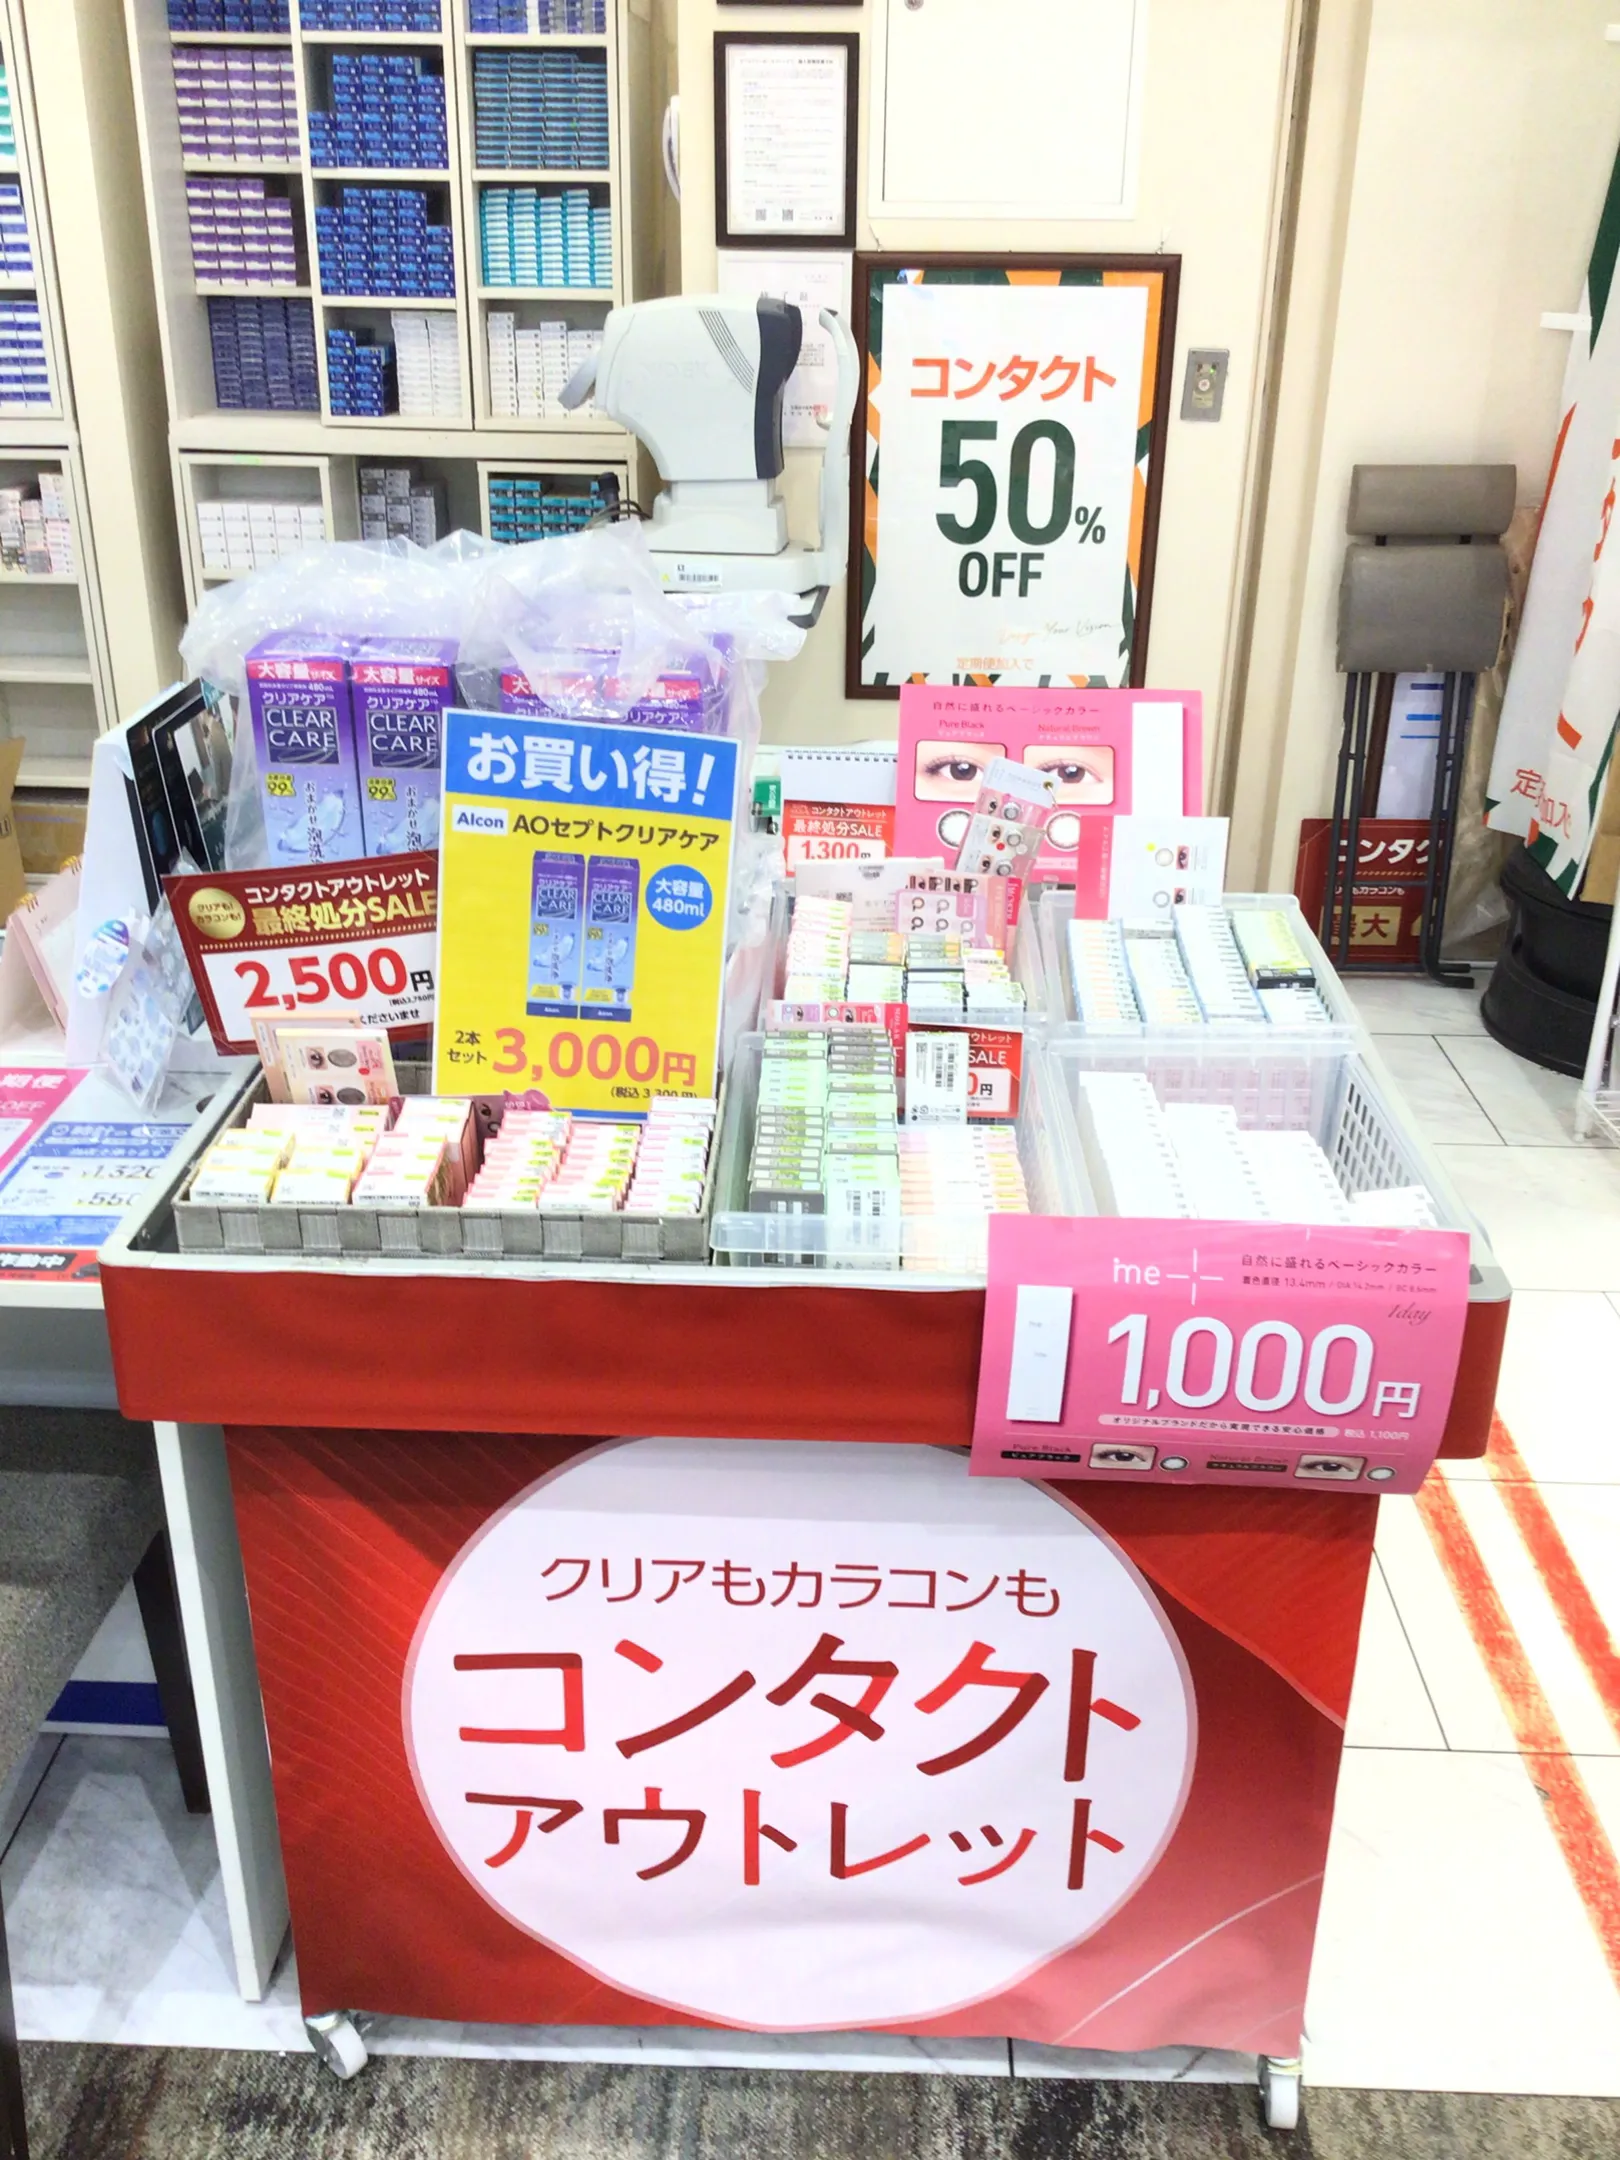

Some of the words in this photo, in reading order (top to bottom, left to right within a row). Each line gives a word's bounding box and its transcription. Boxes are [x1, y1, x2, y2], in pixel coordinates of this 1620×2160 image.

[910, 354, 1117, 402] コンタクト
[936, 418, 1107, 547] 50%
[958, 551, 1045, 598] OFF
[258, 661, 336, 681] 大容量サイズ
[956, 656, 1034, 672] 定期便加入で
[364, 667, 440, 686] 大容量サイズ
[262, 691, 326, 707] クリアケア
[367, 696, 430, 711] クリアケア
[266, 709, 334, 728] CLEAR
[370, 713, 437, 733] CLEAR
[961, 720, 985, 729] Black
[269, 730, 336, 748] CARE
[372, 735, 439, 752] CARE
[467, 732, 716, 807] お買い得!
[456, 811, 505, 829] Alcon
[793, 819, 883, 837] 最終処分SALE
[512, 814, 720, 852] AOセプトクリアケア
[244, 868, 430, 905] コンタクトアウトレット
[538, 888, 576, 900] CLEAR
[655, 878, 705, 899] 大容量
[538, 900, 573, 911] CARE
[592, 893, 631, 904] CLEAR
[652, 897, 705, 917] 480ml
[252, 890, 437, 936] 最終処分SALE
[592, 905, 628, 914] CARE
[234, 948, 434, 1010] 2,500円
[455, 1030, 481, 1046] 2本
[447, 1049, 488, 1065] セット
[492, 1027, 696, 1087] 3,000円
[1241, 1254, 1437, 1274] 自然に盛れるベーシックカラー
[1284, 1277, 1326, 1289] 13.4mm
[1107, 1313, 1421, 1418] 1,000円
[1013, 1443, 1038, 1451] Pure
[541, 1556, 1061, 1618] クリアもカラコンも
[453, 1631, 1142, 1782] コンタクト
[464, 1785, 1125, 1891] アウトレット
